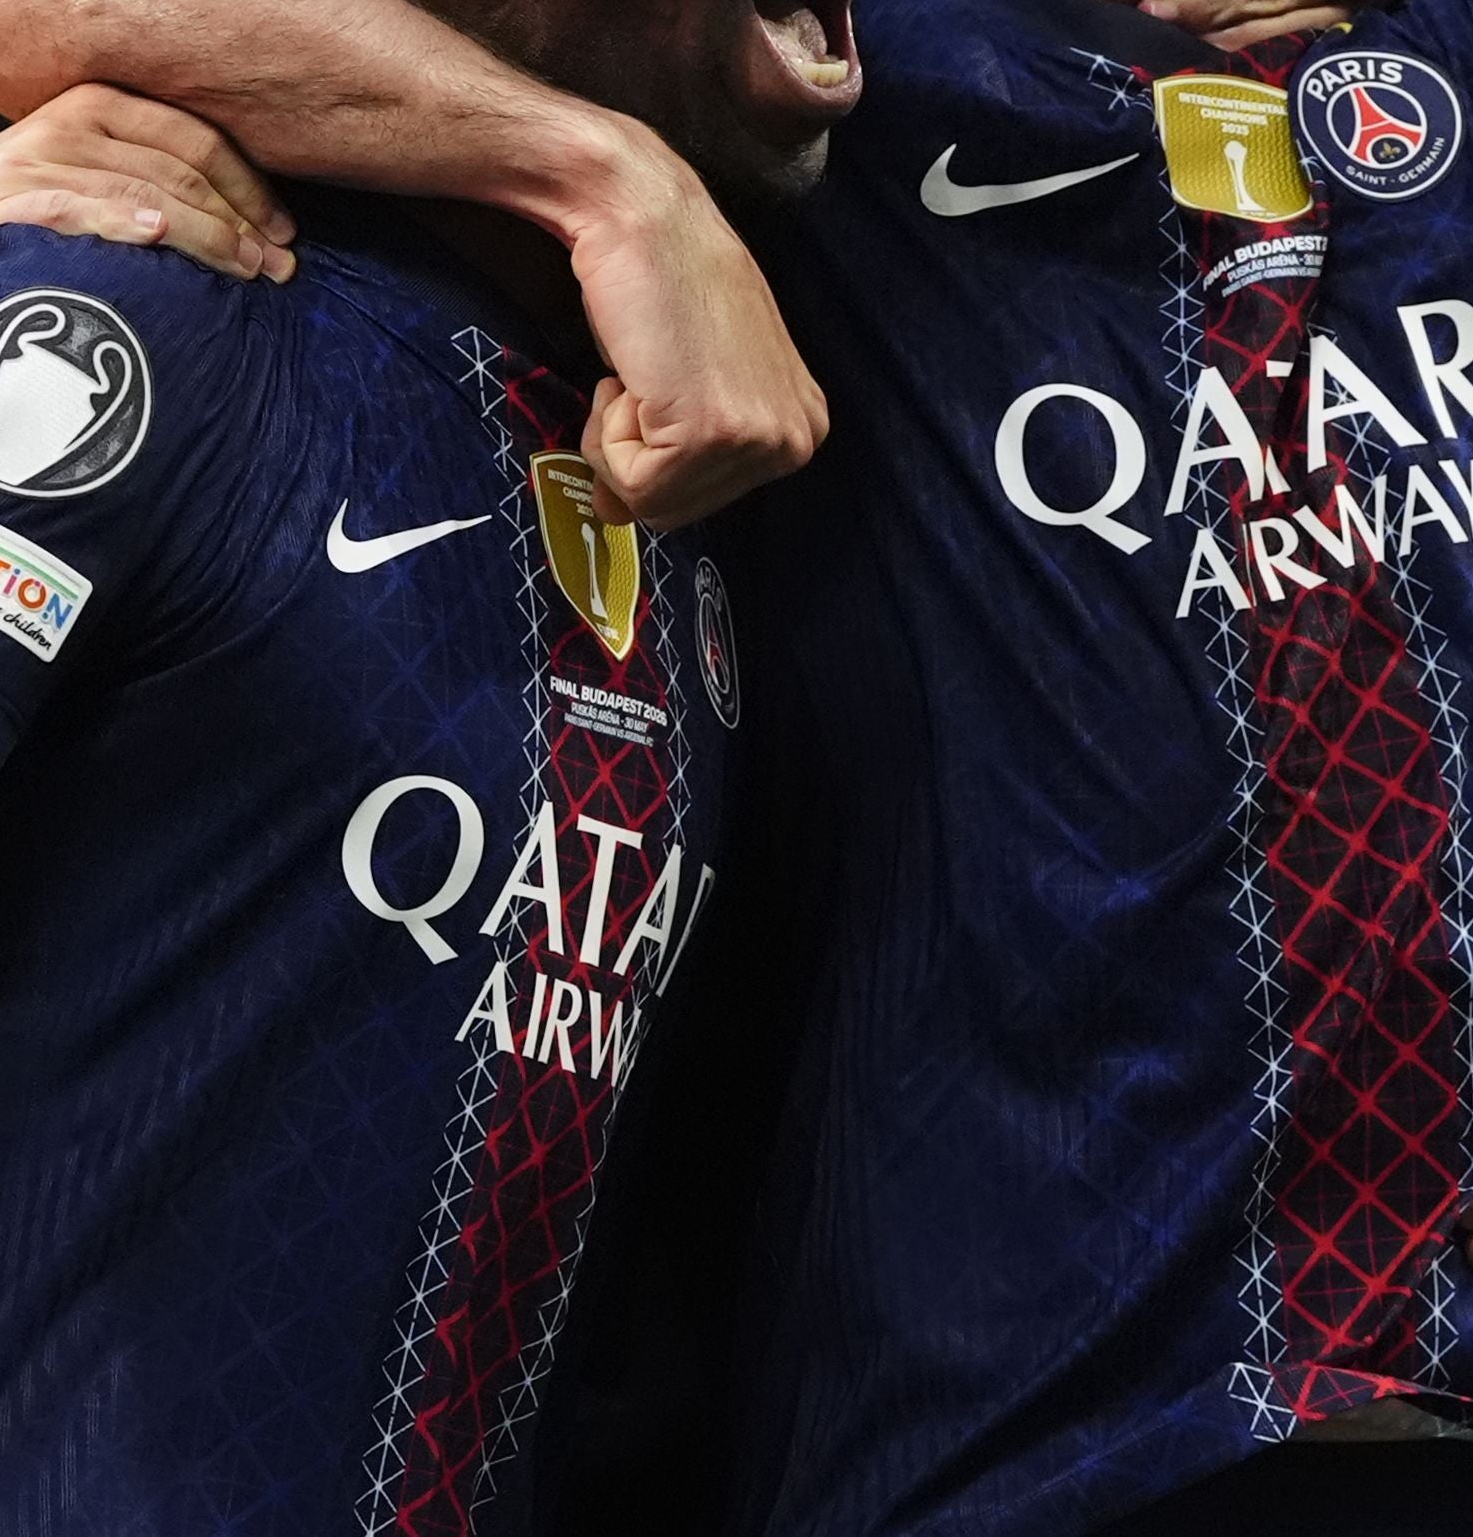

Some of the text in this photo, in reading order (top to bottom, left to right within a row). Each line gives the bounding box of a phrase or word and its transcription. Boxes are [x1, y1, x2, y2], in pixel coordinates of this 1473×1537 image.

[1306, 59, 1403, 102] PARIS
[1200, 107, 1268, 126] CHAMPIONS
[1344, 165, 1387, 186] SAINT
[1398, 137, 1446, 183] GERMAIN
[1234, 235, 1322, 263] BUDAPEST
[2, 611, 53, 652] children
[550, 675, 667, 727] FINAL BUDAPEST 2026
[454, 961, 645, 1090] AIRW
